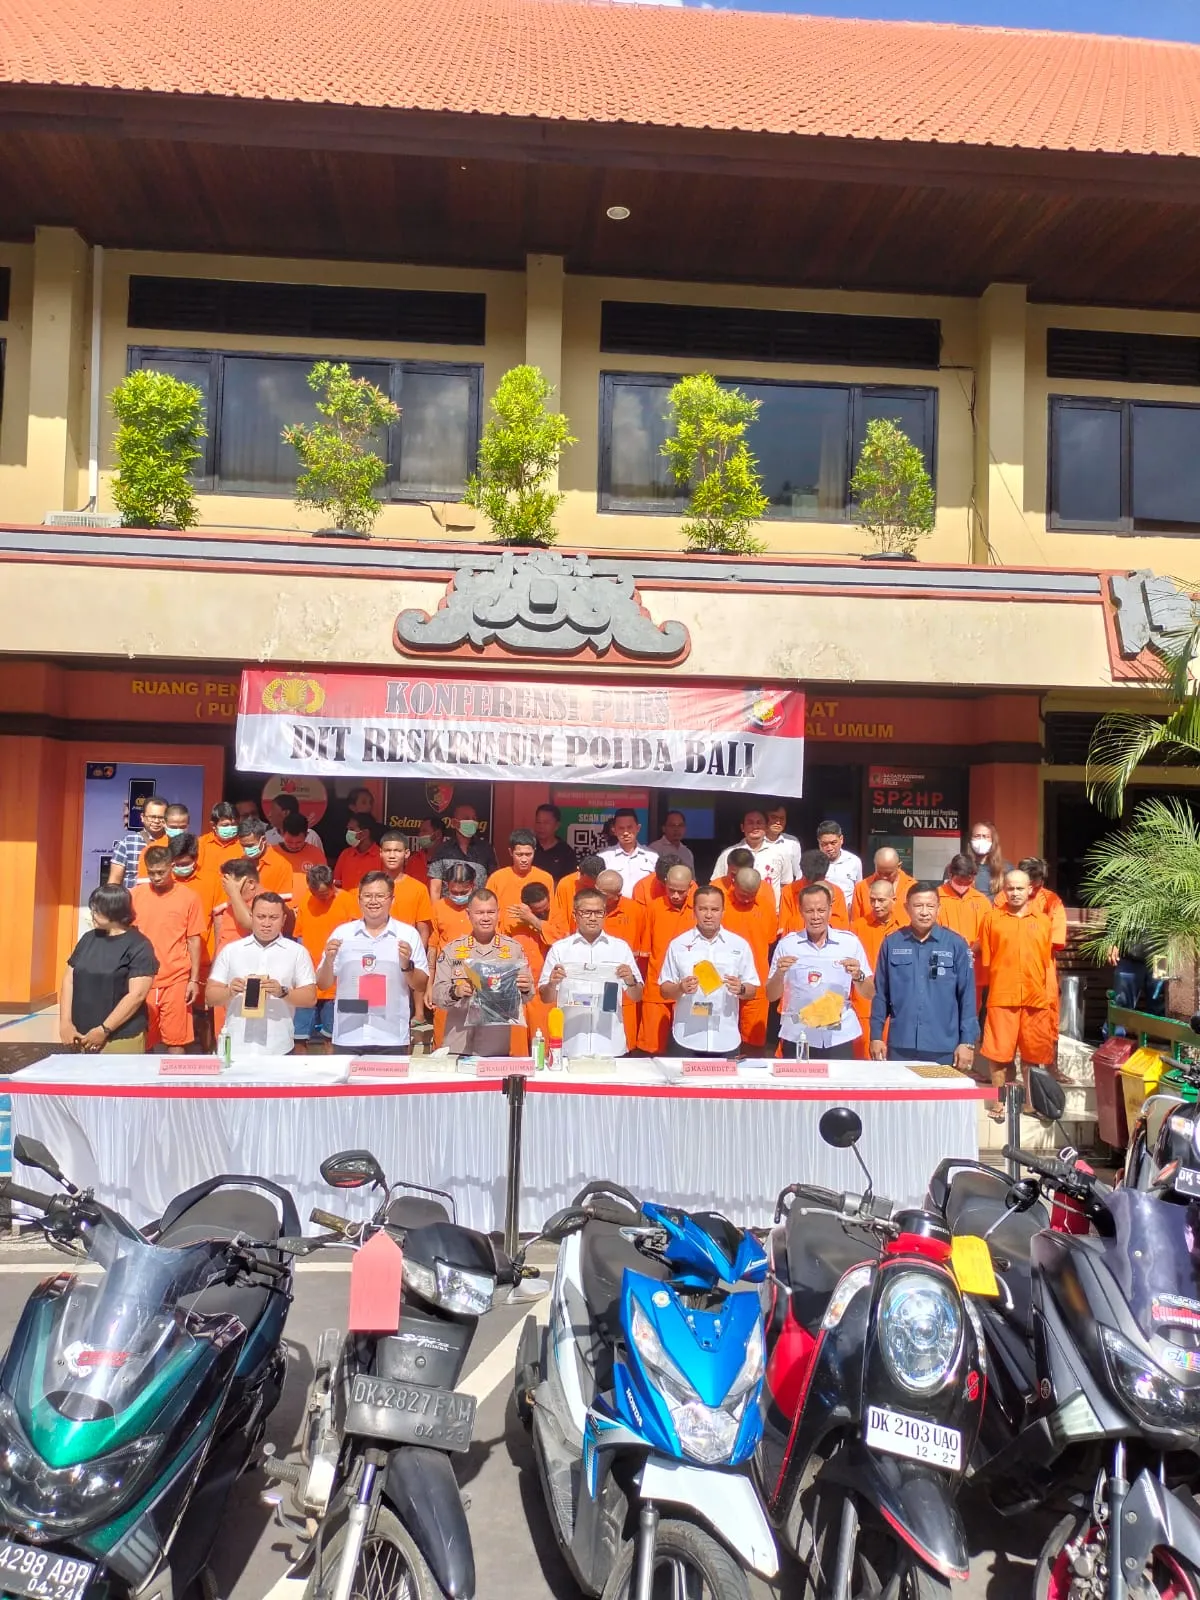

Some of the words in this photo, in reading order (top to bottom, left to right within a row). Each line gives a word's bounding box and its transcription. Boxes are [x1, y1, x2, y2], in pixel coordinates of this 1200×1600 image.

[131, 680, 198, 695] RUANG
[207, 702, 239, 716] PU
[385, 681, 579, 720] KONFERENSI
[591, 689, 671, 724] PERS
[805, 701, 839, 718] AT
[833, 723, 894, 738] UMUM
[290, 724, 352, 762] DIT
[361, 726, 555, 767] RESKRIMUM
[565, 735, 674, 772] POLDA
[684, 739, 755, 778] BALI
[873, 790, 943, 807] SP2HP
[578, 814, 599, 822] SCAN
[903, 816, 958, 829] ONLINE
[354, 1381, 377, 1405] DK
[384, 1387, 431, 1416] 2827
[626, 1387, 643, 1428] HONDA
[871, 1410, 890, 1433] DK
[895, 1417, 930, 1443] 2103
[0, 1545, 49, 1577] 4298
[46, 1558, 89, 1587] ABP
